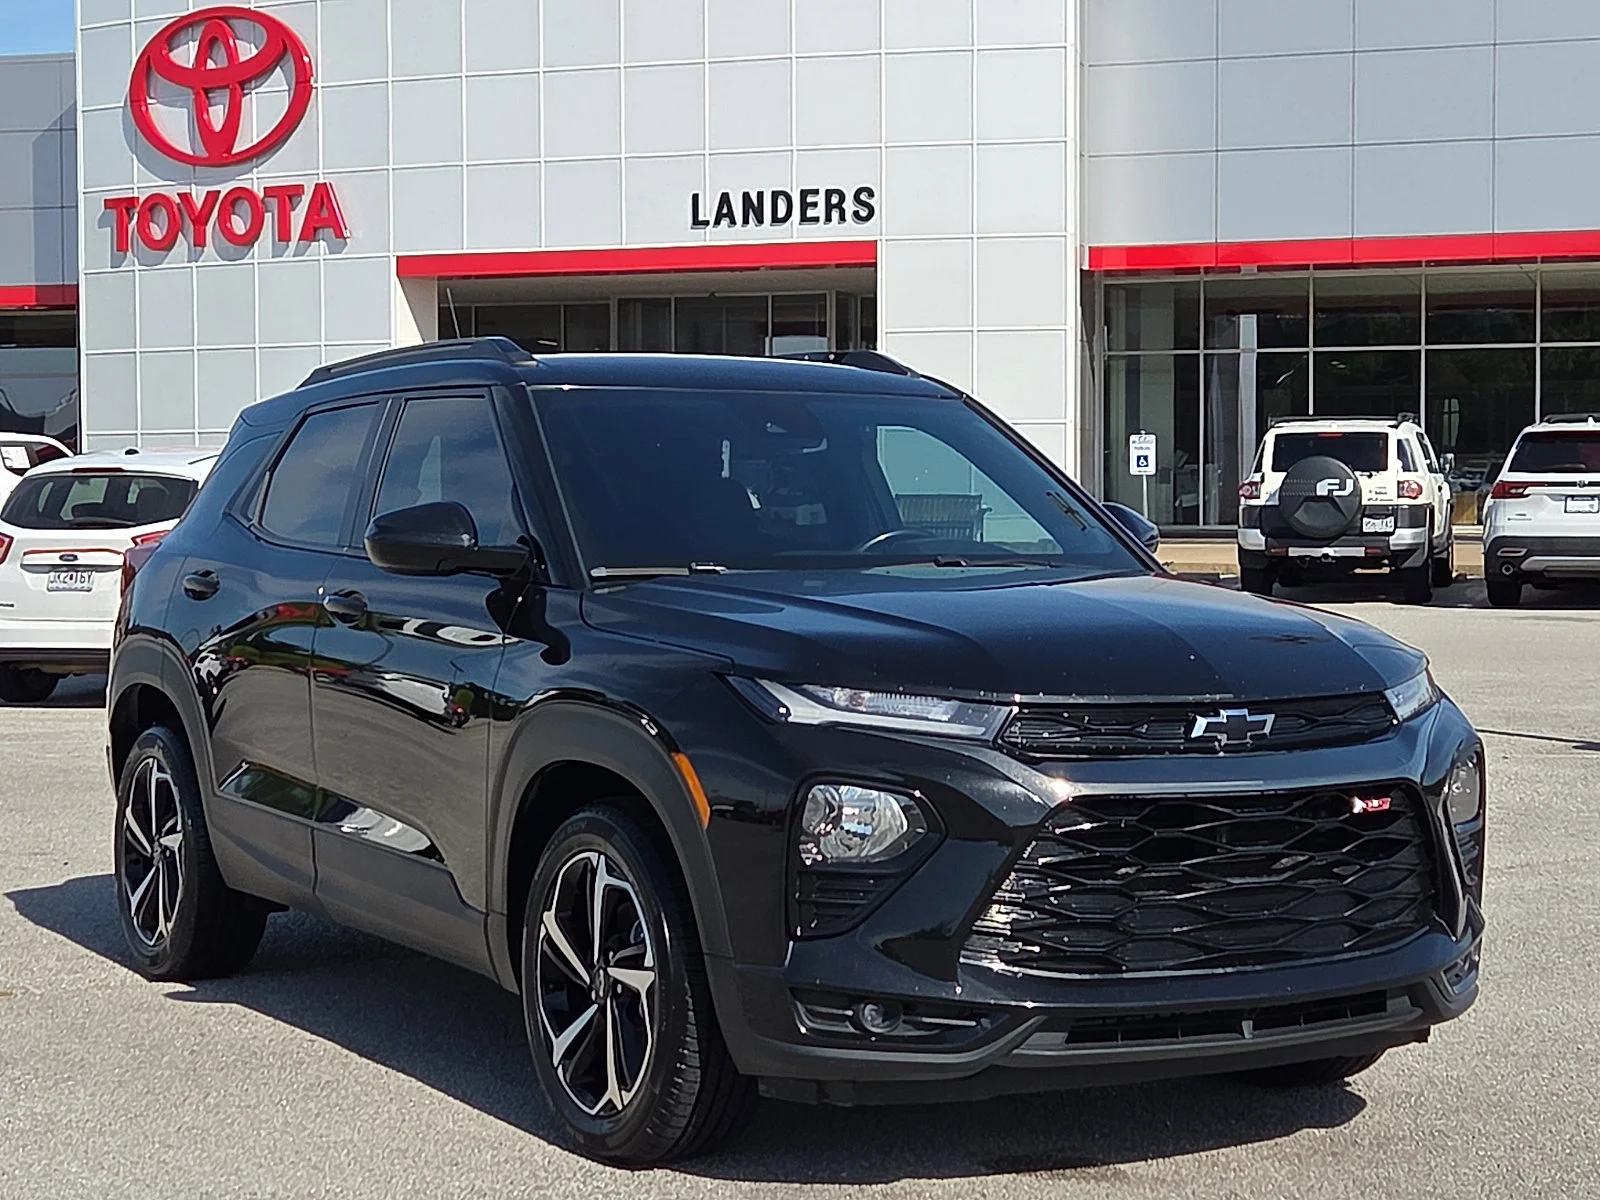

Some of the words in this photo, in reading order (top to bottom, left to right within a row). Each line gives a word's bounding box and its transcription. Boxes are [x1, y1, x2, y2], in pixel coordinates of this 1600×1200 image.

[104, 181, 350, 253] TOYOTA
[690, 186, 876, 229] LANDERS
[1316, 478, 1354, 496] FJ
